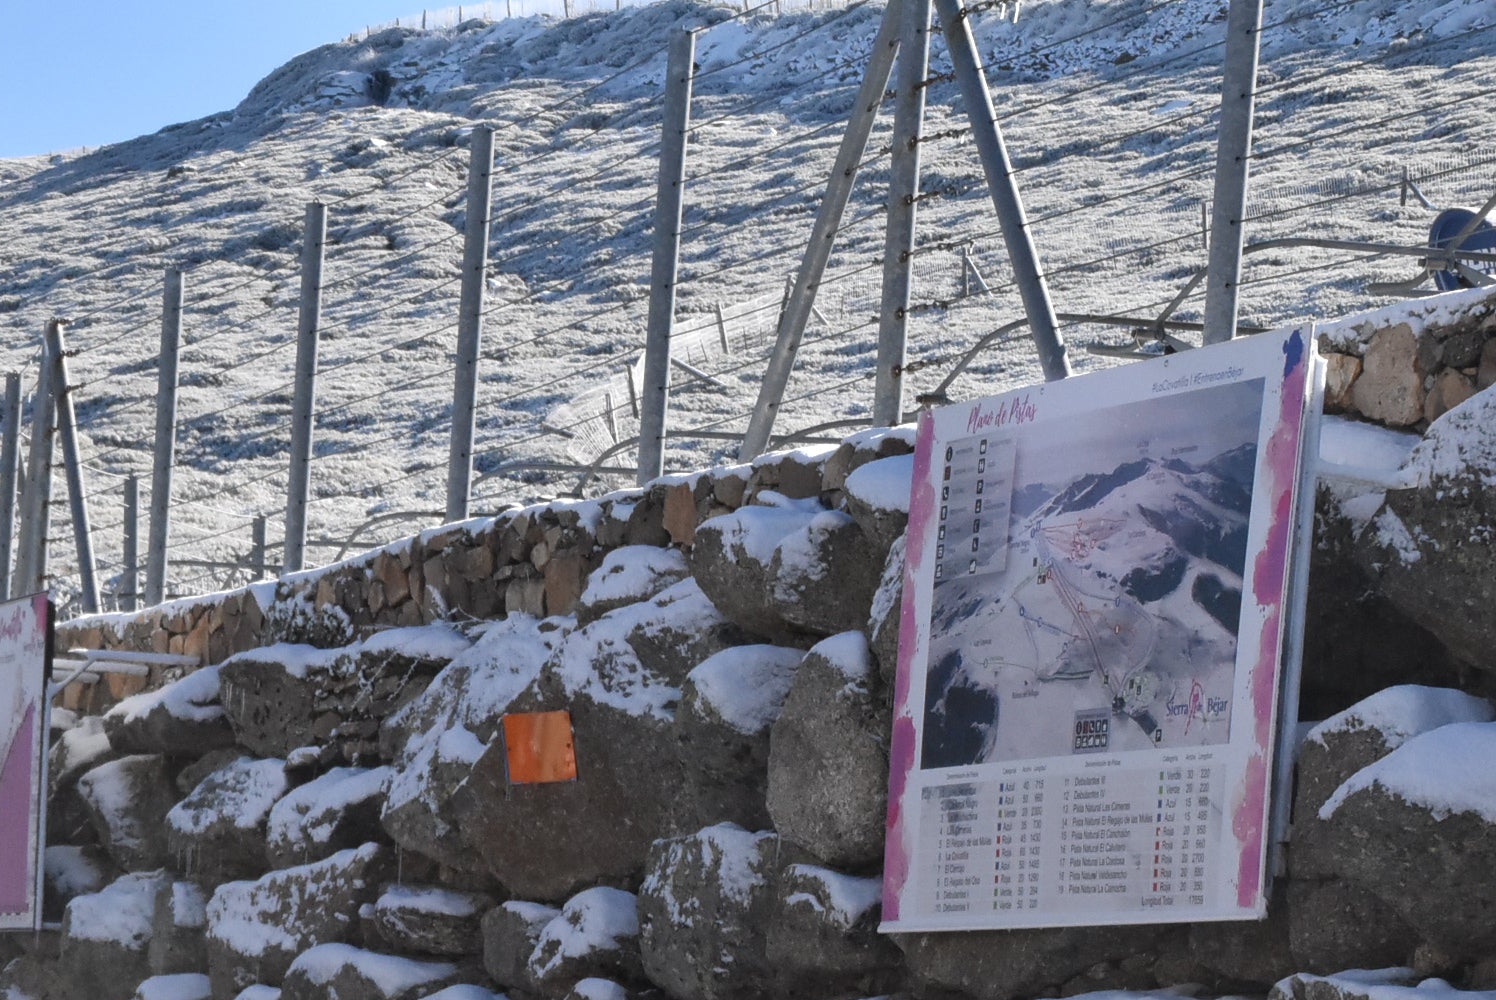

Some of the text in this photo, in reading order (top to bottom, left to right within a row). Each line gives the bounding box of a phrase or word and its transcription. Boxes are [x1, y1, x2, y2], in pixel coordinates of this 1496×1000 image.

[967, 393, 1037, 434] Plano de Pistas
[1166, 700, 1188, 717] Sierra
[1207, 696, 1228, 717] Béjar
[1074, 776, 1101, 786] Debutantes
[1166, 770, 1181, 780] Verde
[1073, 790, 1100, 799] Debutantes
[1166, 785, 1180, 794] Verde
[1199, 782, 1209, 792] 220
[1141, 895, 1161, 906] Longitud
[1162, 895, 1173, 905] Total
